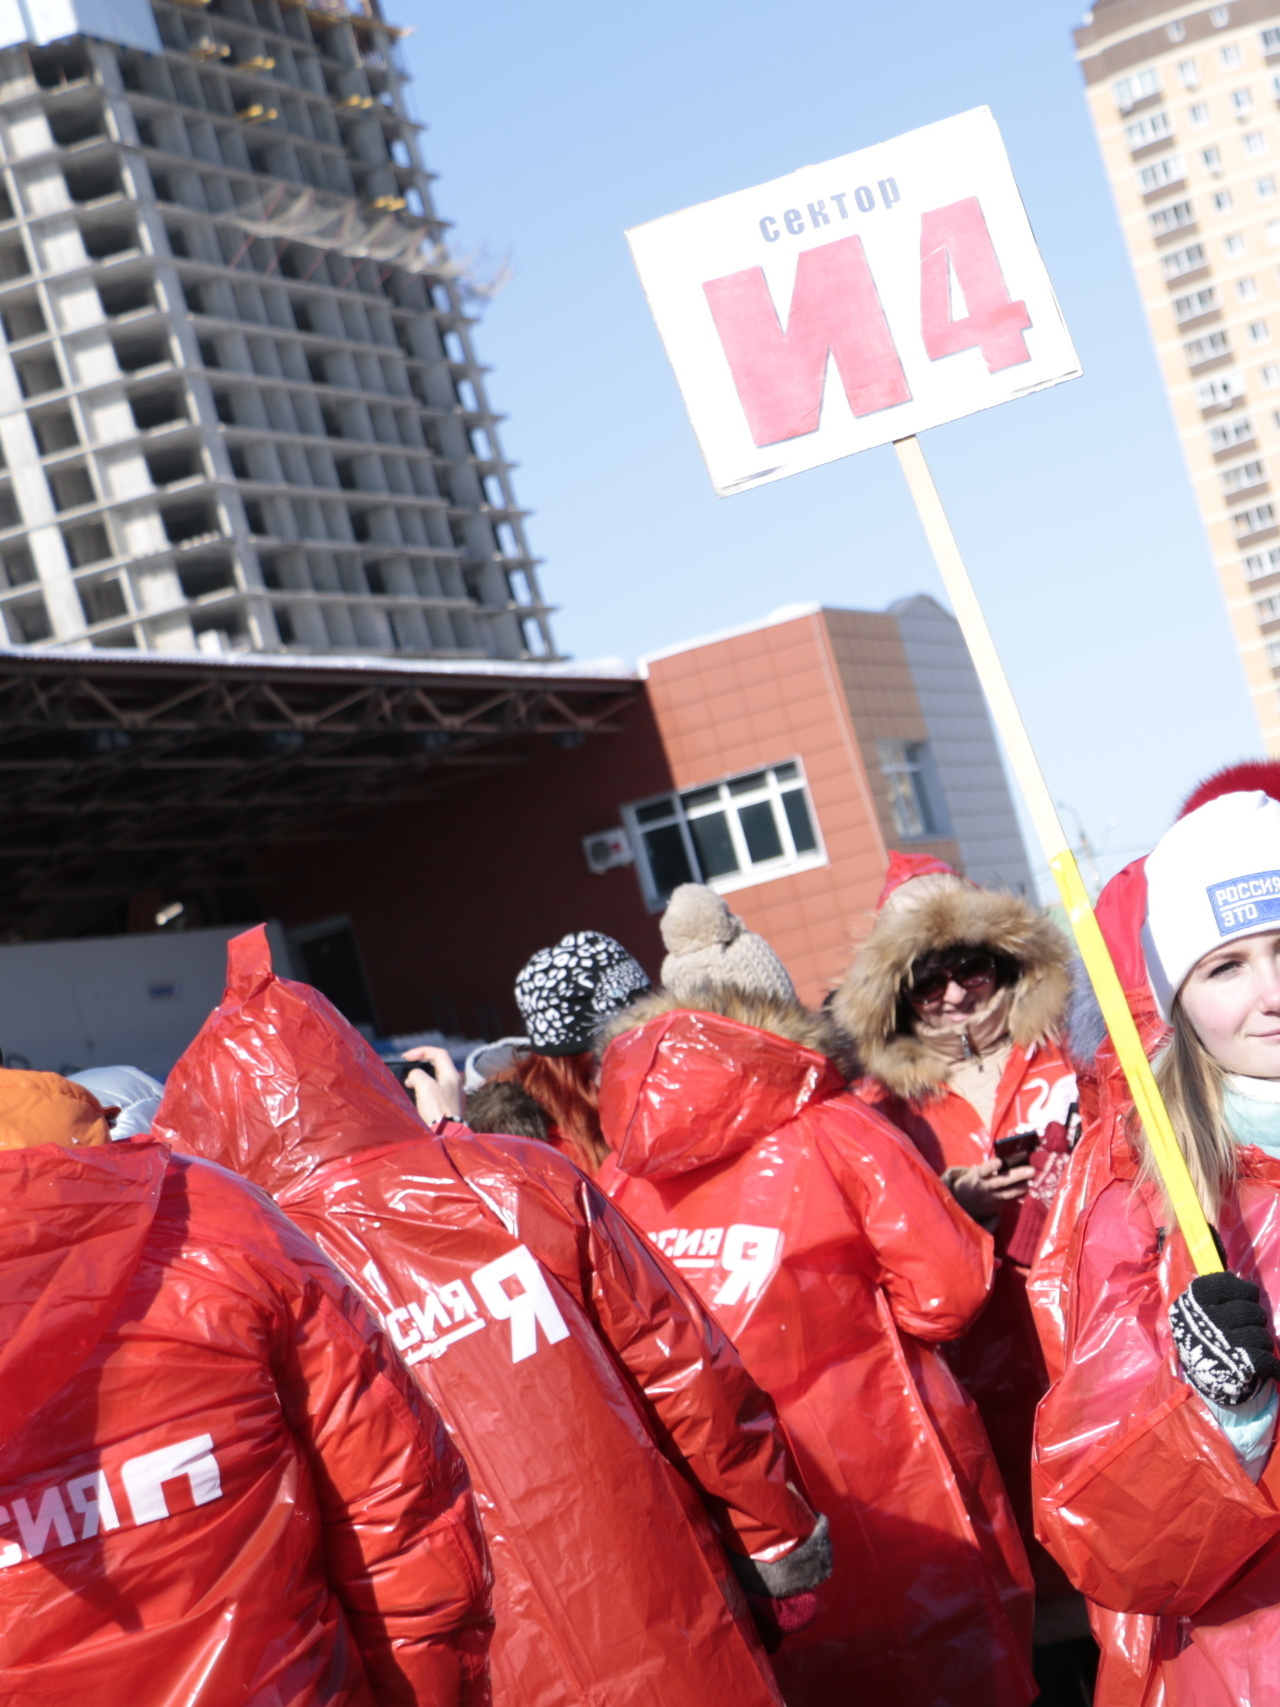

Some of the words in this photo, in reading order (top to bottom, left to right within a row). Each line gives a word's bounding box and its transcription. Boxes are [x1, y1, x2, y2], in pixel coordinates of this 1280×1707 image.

[759, 176, 901, 243] сектор
[1221, 903, 1258, 927] ЭТО
[647, 1227, 725, 1257] СИЯ
[713, 1223, 782, 1305] Я
[471, 1244, 570, 1364] Я
